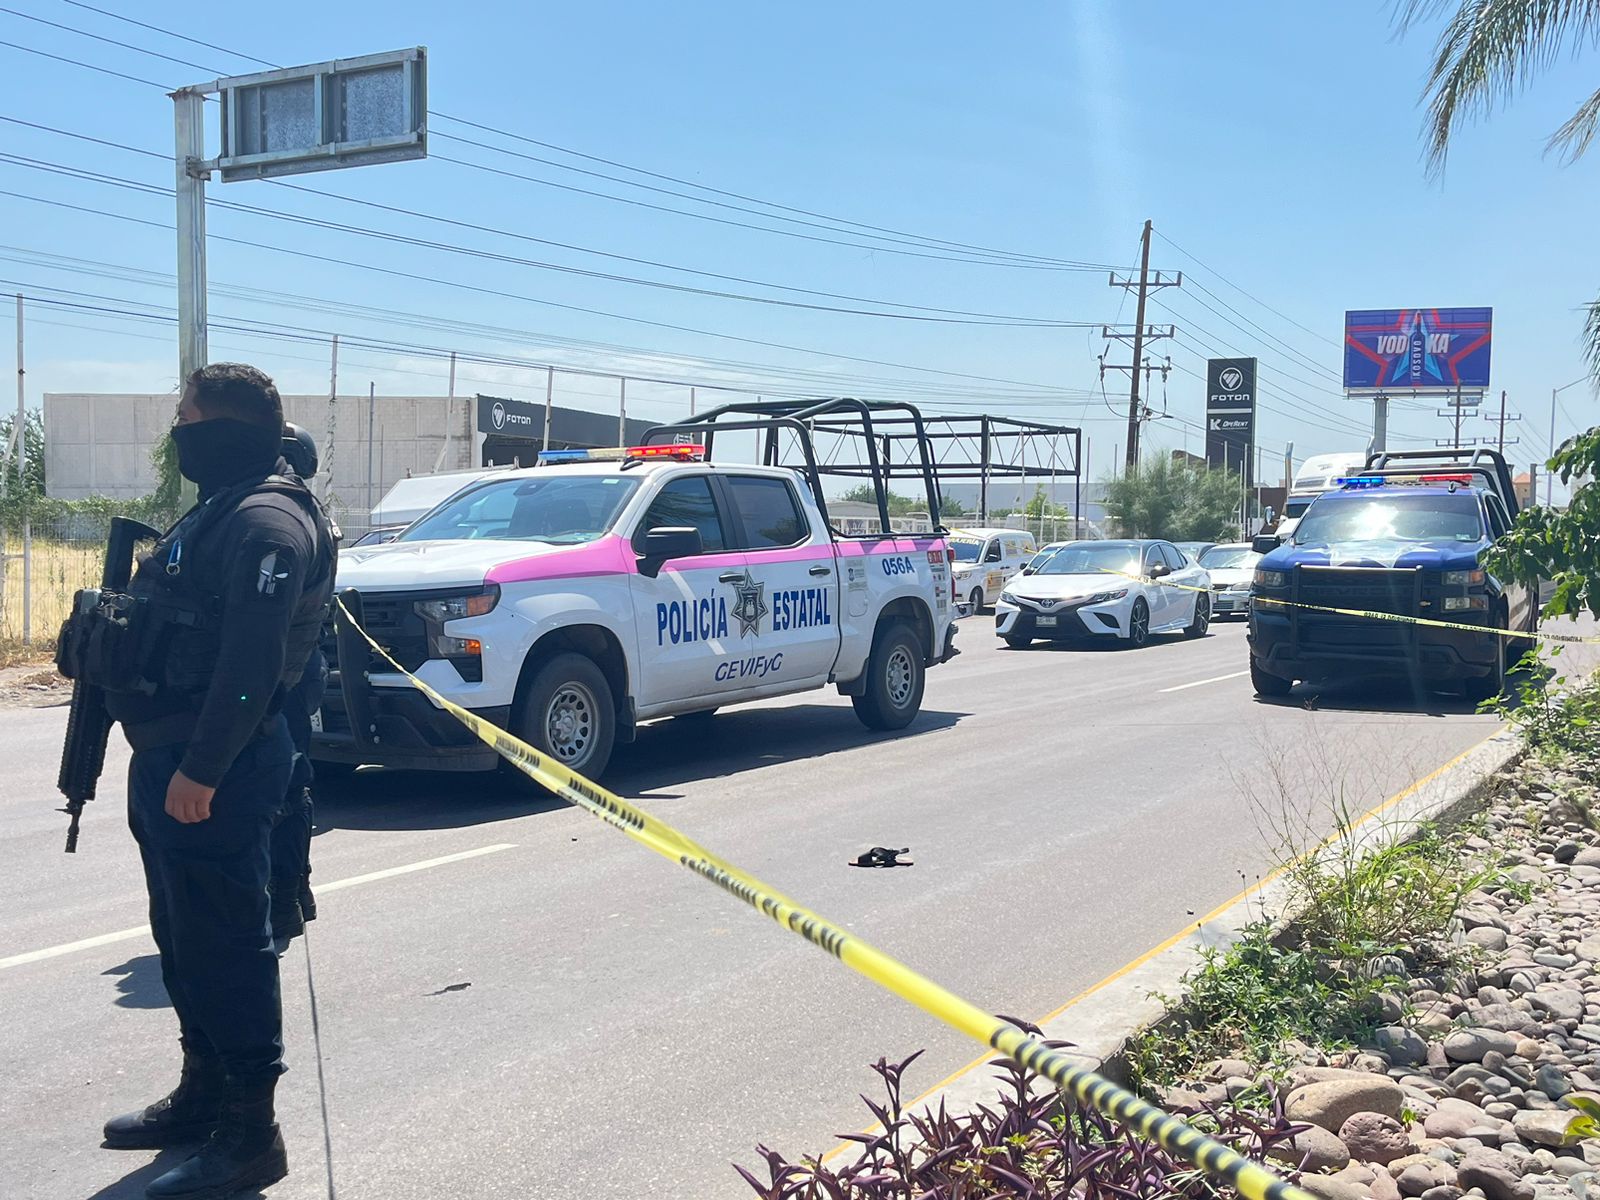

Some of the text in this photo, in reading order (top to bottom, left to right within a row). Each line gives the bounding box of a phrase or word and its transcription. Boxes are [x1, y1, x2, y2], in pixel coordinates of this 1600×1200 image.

[1412, 340, 1422, 377] KOSOVO
[1210, 393, 1250, 402] FOTON
[506, 414, 532, 425] FOTON
[881, 556, 915, 576] 056A
[656, 588, 831, 646] POLICÍA ESTATAL
[714, 652, 784, 682] GEVIFyG
